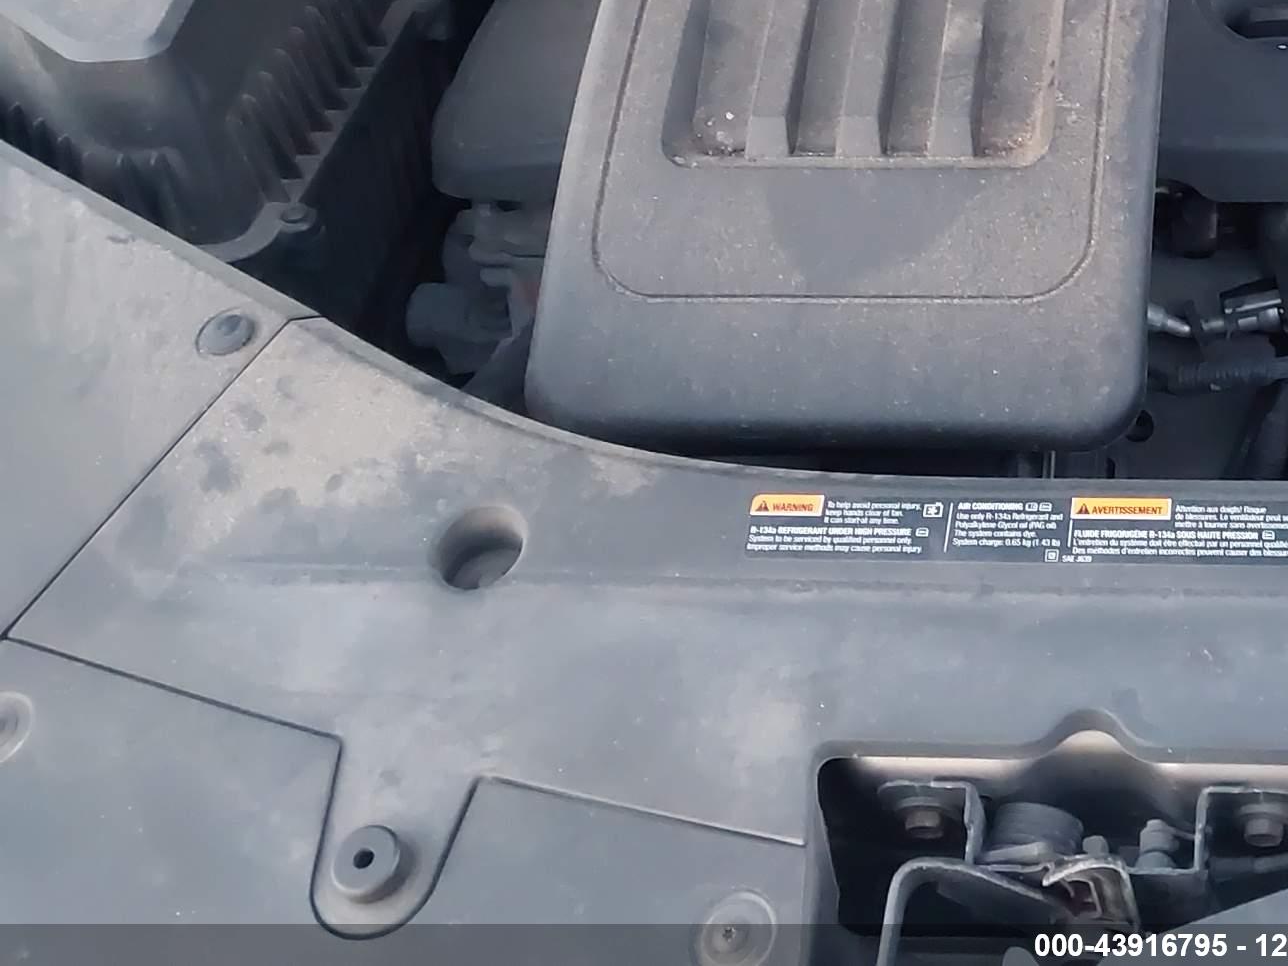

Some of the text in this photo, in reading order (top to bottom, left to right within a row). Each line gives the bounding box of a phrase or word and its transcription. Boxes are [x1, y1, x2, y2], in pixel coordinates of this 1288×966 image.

[772, 502, 813, 512] WARNING
[828, 501, 836, 509] To
[837, 501, 851, 509] help
[852, 502, 870, 510] avoid
[872, 502, 901, 511] personal
[1092, 506, 1163, 515] AVERTISSEMENT
[1176, 505, 1206, 513] Attention
[1206, 506, 1218, 514] aux
[1244, 506, 1267, 514] Risque
[826, 509, 842, 517] keep
[843, 509, 864, 517] hands
[864, 510, 880, 518] clear
[882, 510, 890, 518] of
[956, 512, 970, 520] Use
[998, 522, 1018, 531] Glycol
[1019, 522, 1028, 531] oil
[1028, 522, 1045, 531] (PAG
[750, 527, 912, 536] R-134a REFRIGERANT UNDER HIGH PRESSURE
[1074, 530, 1100, 538] FLUIDE
[1148, 530, 1176, 539] R-134a
[1176, 531, 1196, 539] SOUS
[1197, 531, 1221, 539] HAUTE
[1222, 531, 1258, 540] PRESSION
[749, 535, 774, 544] System
[775, 535, 782, 544] to
[782, 535, 792, 544] be
[793, 536, 822, 544] serviced
[823, 536, 832, 545] by
[832, 536, 862, 545] qualified
[862, 537, 895, 545] personnel
[747, 544, 777, 552] Improper
[778, 544, 803, 552] service
[804, 544, 834, 552] methods
[834, 544, 850, 553] may
[850, 544, 870, 553] cause
[872, 545, 902, 553] personal
[1072, 547, 1086, 555] Des
[1086, 547, 1120, 555] méthodes
[1121, 548, 1158, 556] d'entretien
[1158, 548, 1196, 556] incorrectes
[1197, 548, 1224, 556] peuvent
[1224, 549, 1248, 557] causer
[1248, 549, 1262, 557] des
[1062, 555, 1076, 563] SAE
